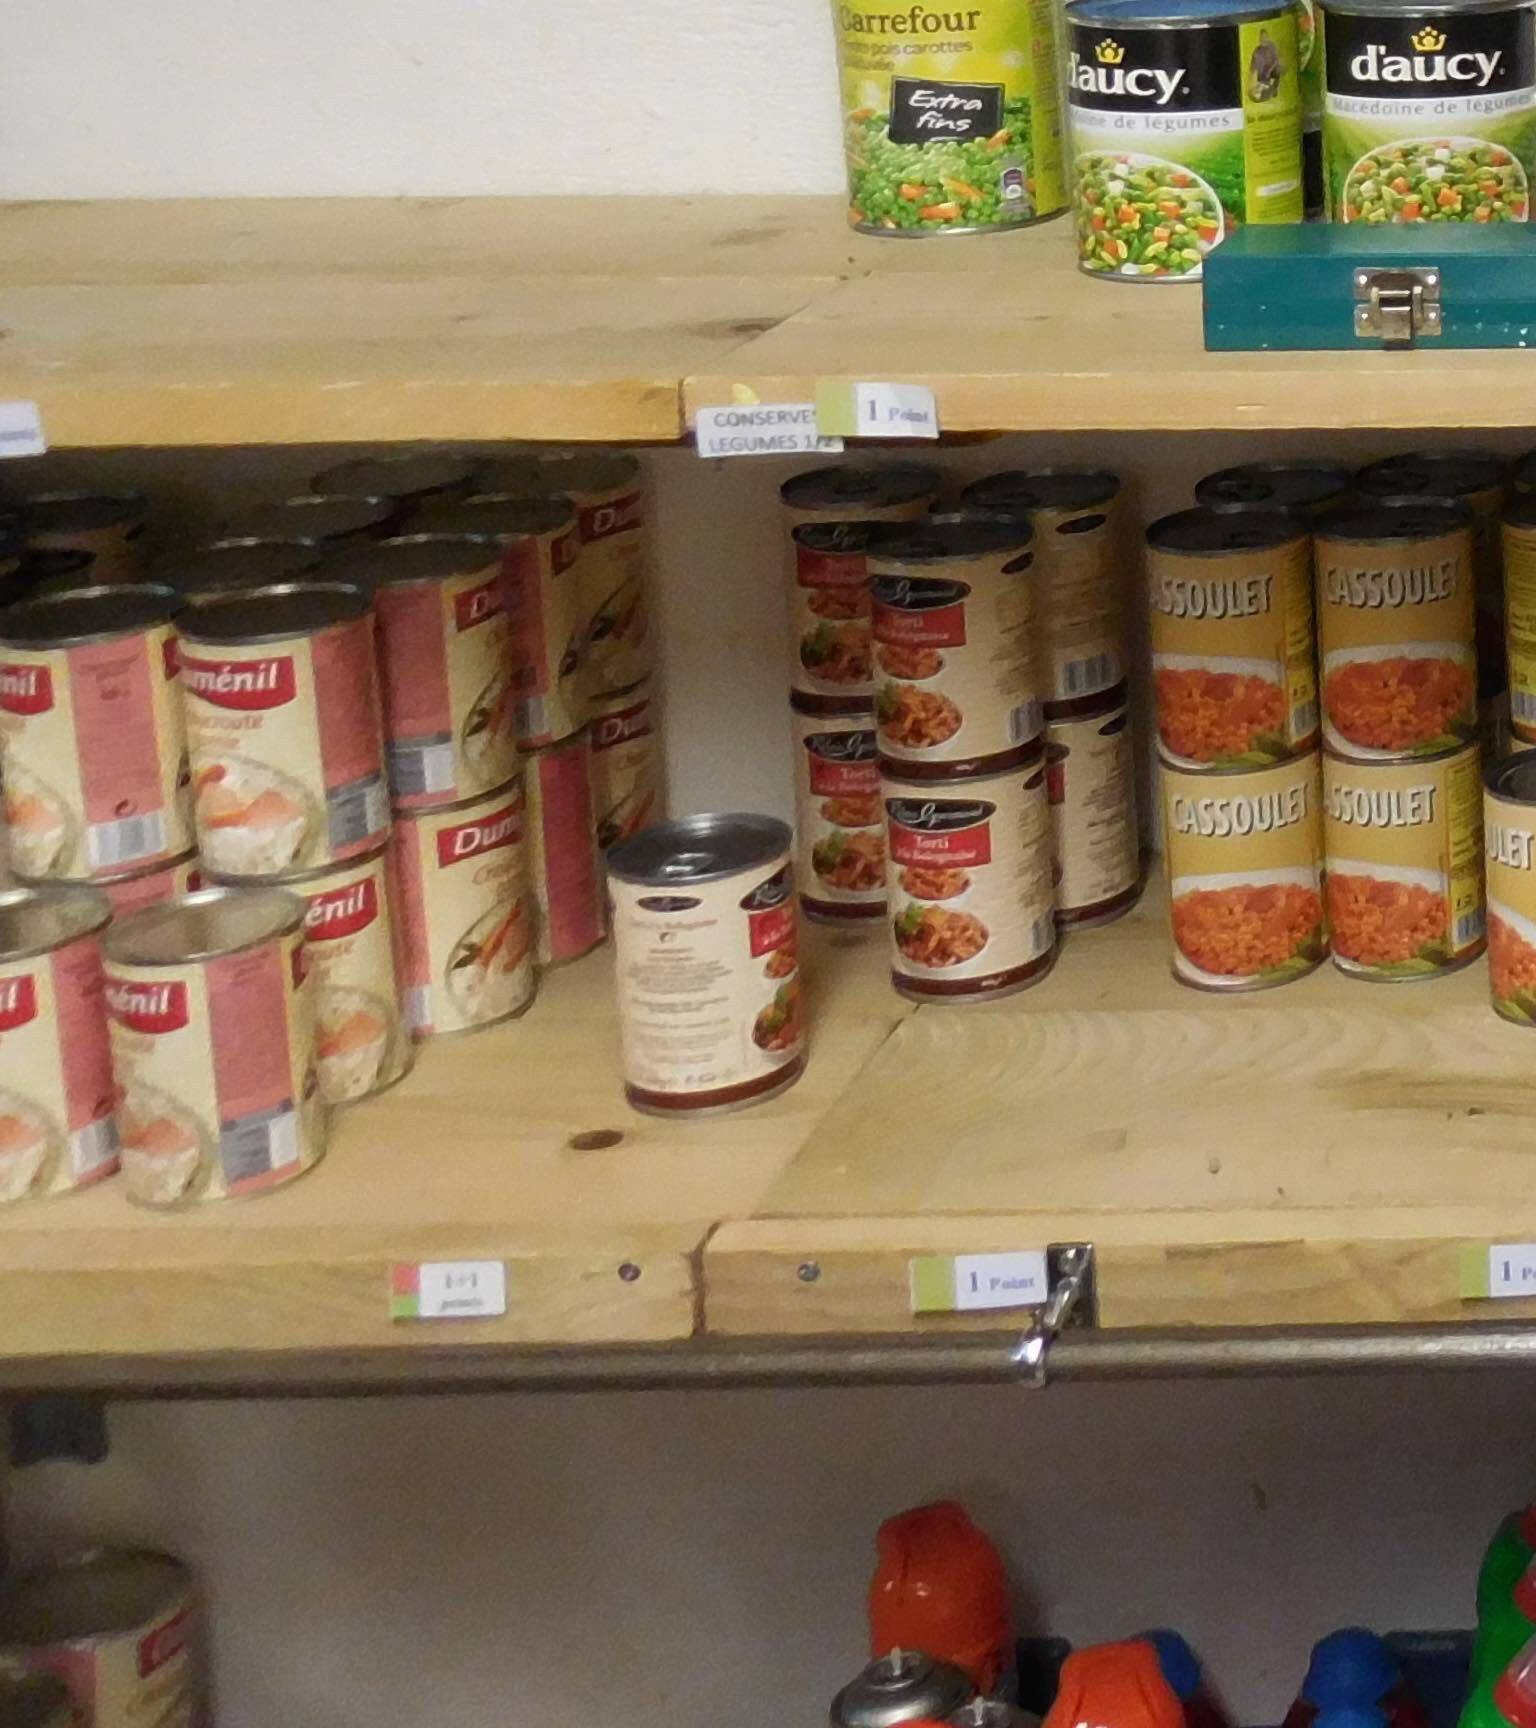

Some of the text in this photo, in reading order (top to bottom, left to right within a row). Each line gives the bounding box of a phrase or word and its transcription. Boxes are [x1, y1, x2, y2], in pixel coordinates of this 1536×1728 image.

[840, 5, 981, 34] Carrefour
[901, 40, 974, 55] carottes
[1350, 44, 1502, 87] d'aucy
[908, 90, 983, 111] Extra
[1333, 90, 1533, 116] Macédoine de légumes
[916, 111, 973, 132] fins
[1114, 111, 1231, 133] de légumes
[867, 399, 877, 422] 1
[709, 434, 798, 453] LEGUMES
[1326, 557, 1459, 609] CASSOULET
[1154, 575, 1273, 620] SSOULET
[192, 663, 279, 693] ménil
[1171, 780, 1309, 838] CASSOULET
[1328, 783, 1437, 827] SSOULET
[305, 887, 366, 927] énil
[107, 983, 171, 1016] énil
[970, 1271, 979, 1292] 1
[1502, 1260, 1511, 1282] 1
